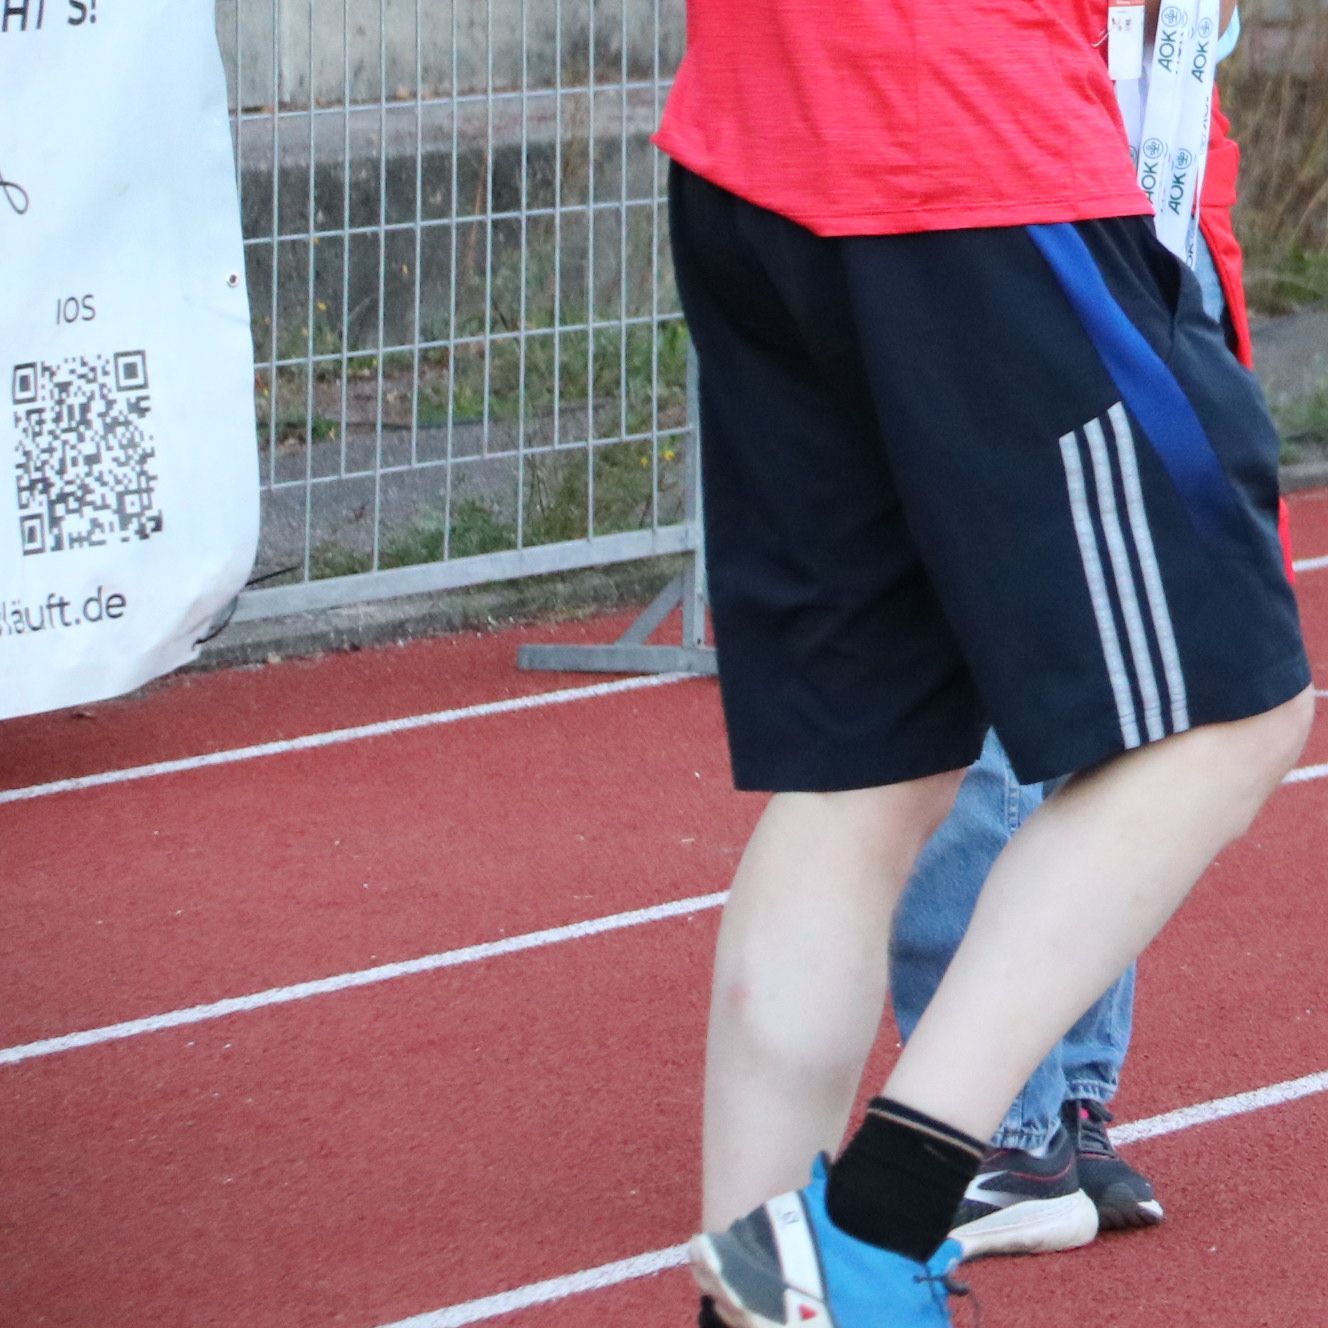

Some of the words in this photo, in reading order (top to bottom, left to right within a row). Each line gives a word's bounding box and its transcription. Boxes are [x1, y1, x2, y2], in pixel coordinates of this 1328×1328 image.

[1158, 29, 1177, 73] AOK
[1191, 40, 1209, 84] AOK
[1168, 172, 1187, 216] AOK
[1, 585, 127, 635] läuft.de
